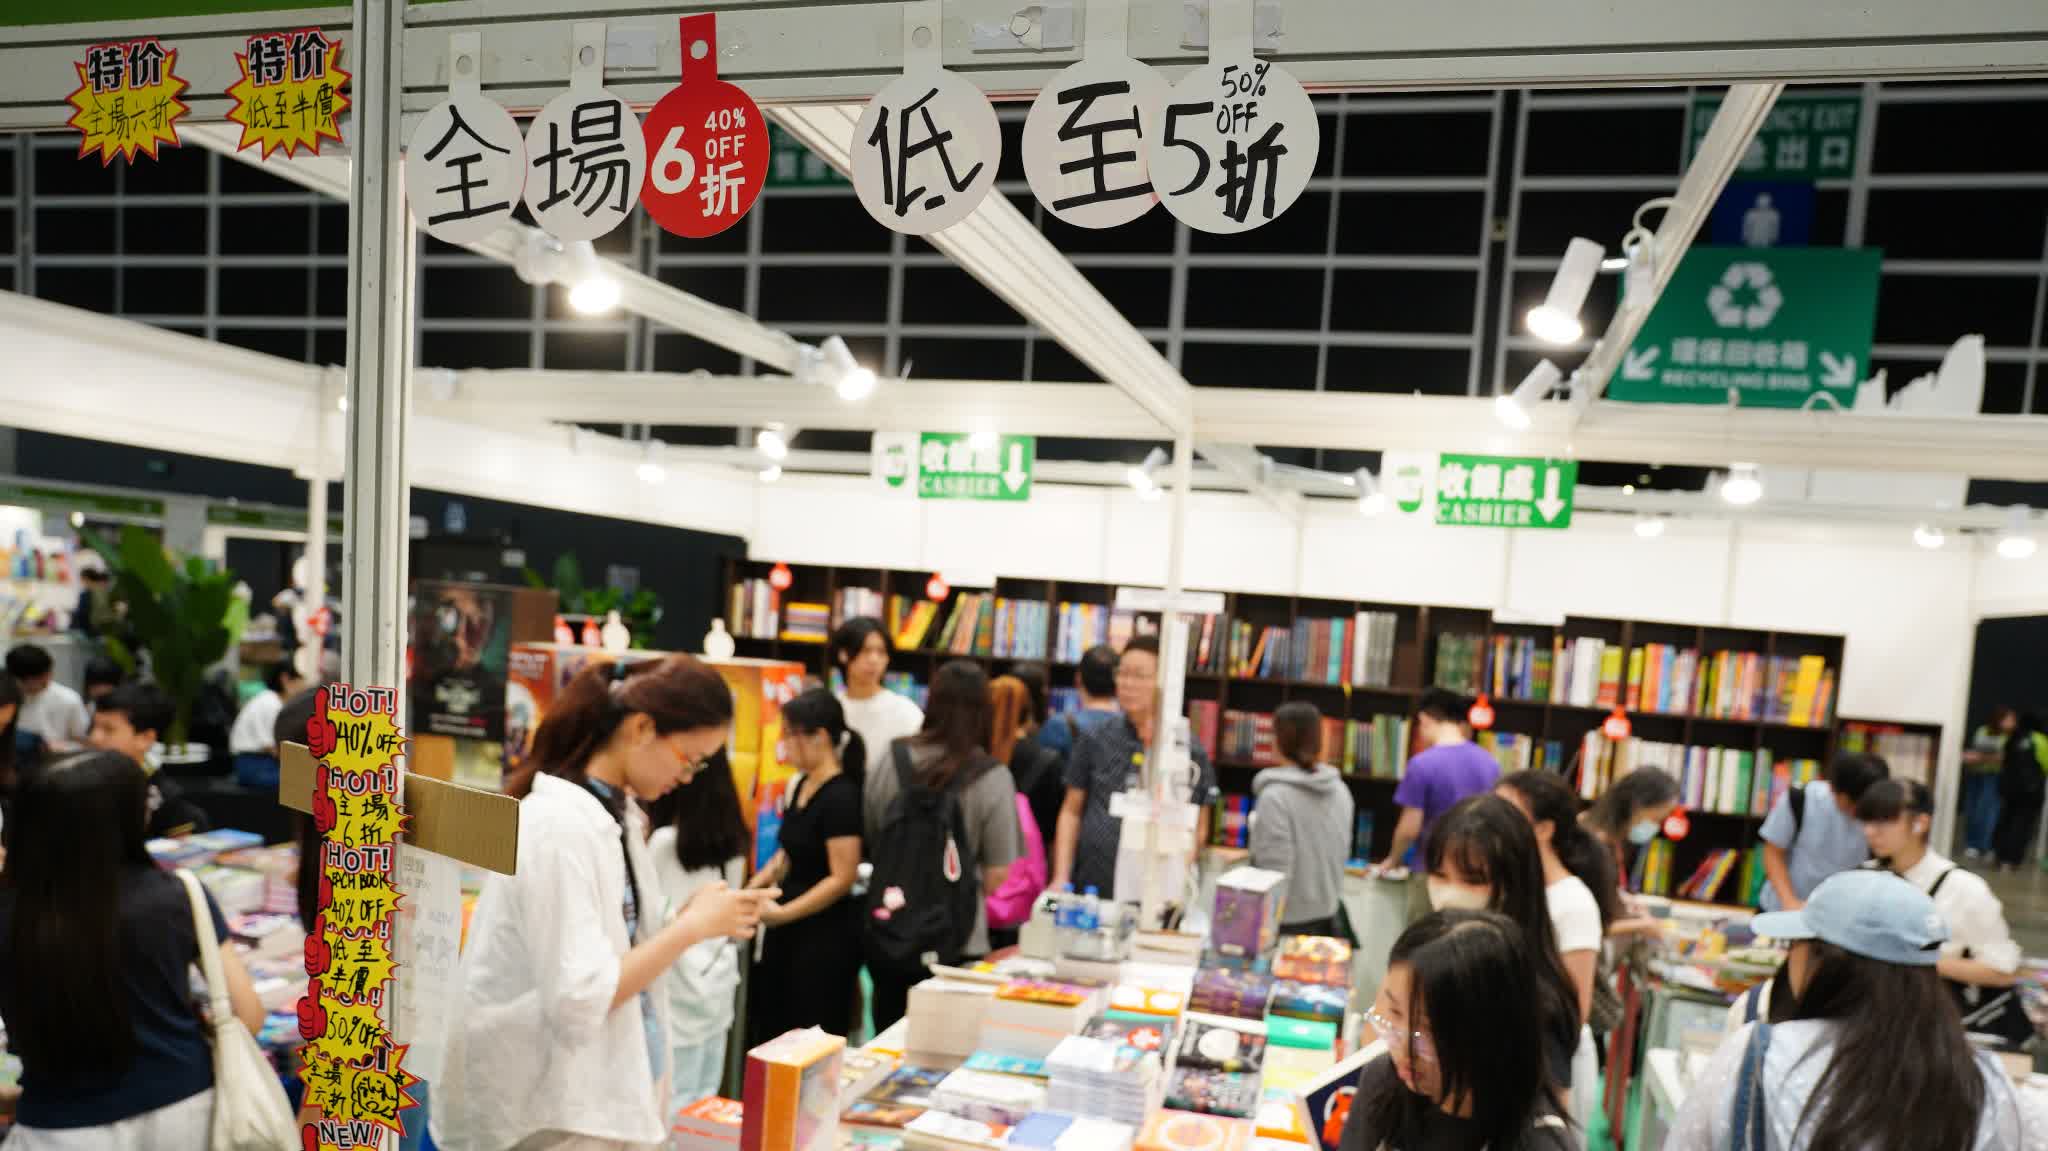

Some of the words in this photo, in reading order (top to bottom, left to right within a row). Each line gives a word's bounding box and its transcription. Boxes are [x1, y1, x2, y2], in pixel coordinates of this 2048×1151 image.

[89, 42, 164, 91] 特价
[250, 32, 326, 84] 特价
[1222, 62, 1270, 98] 50%
[83, 96, 171, 140] 全場六折
[248, 83, 333, 131] 低至半價
[704, 107, 746, 131] 40%
[1217, 102, 1258, 134] OFF
[705, 134, 746, 160] OFF
[1437, 502, 1532, 525] CASHIER
[330, 684, 396, 716] HOT!
[337, 720, 372, 758] 40%
[376, 734, 397, 753] OFF
[328, 842, 390, 873] HOT!
[359, 872, 389, 890] BOOK
[332, 897, 355, 925] 40%
[360, 899, 385, 921] OFF
[328, 1011, 362, 1046] 50%
[359, 1023, 381, 1048] OFF
[319, 1120, 382, 1148] NEW!
